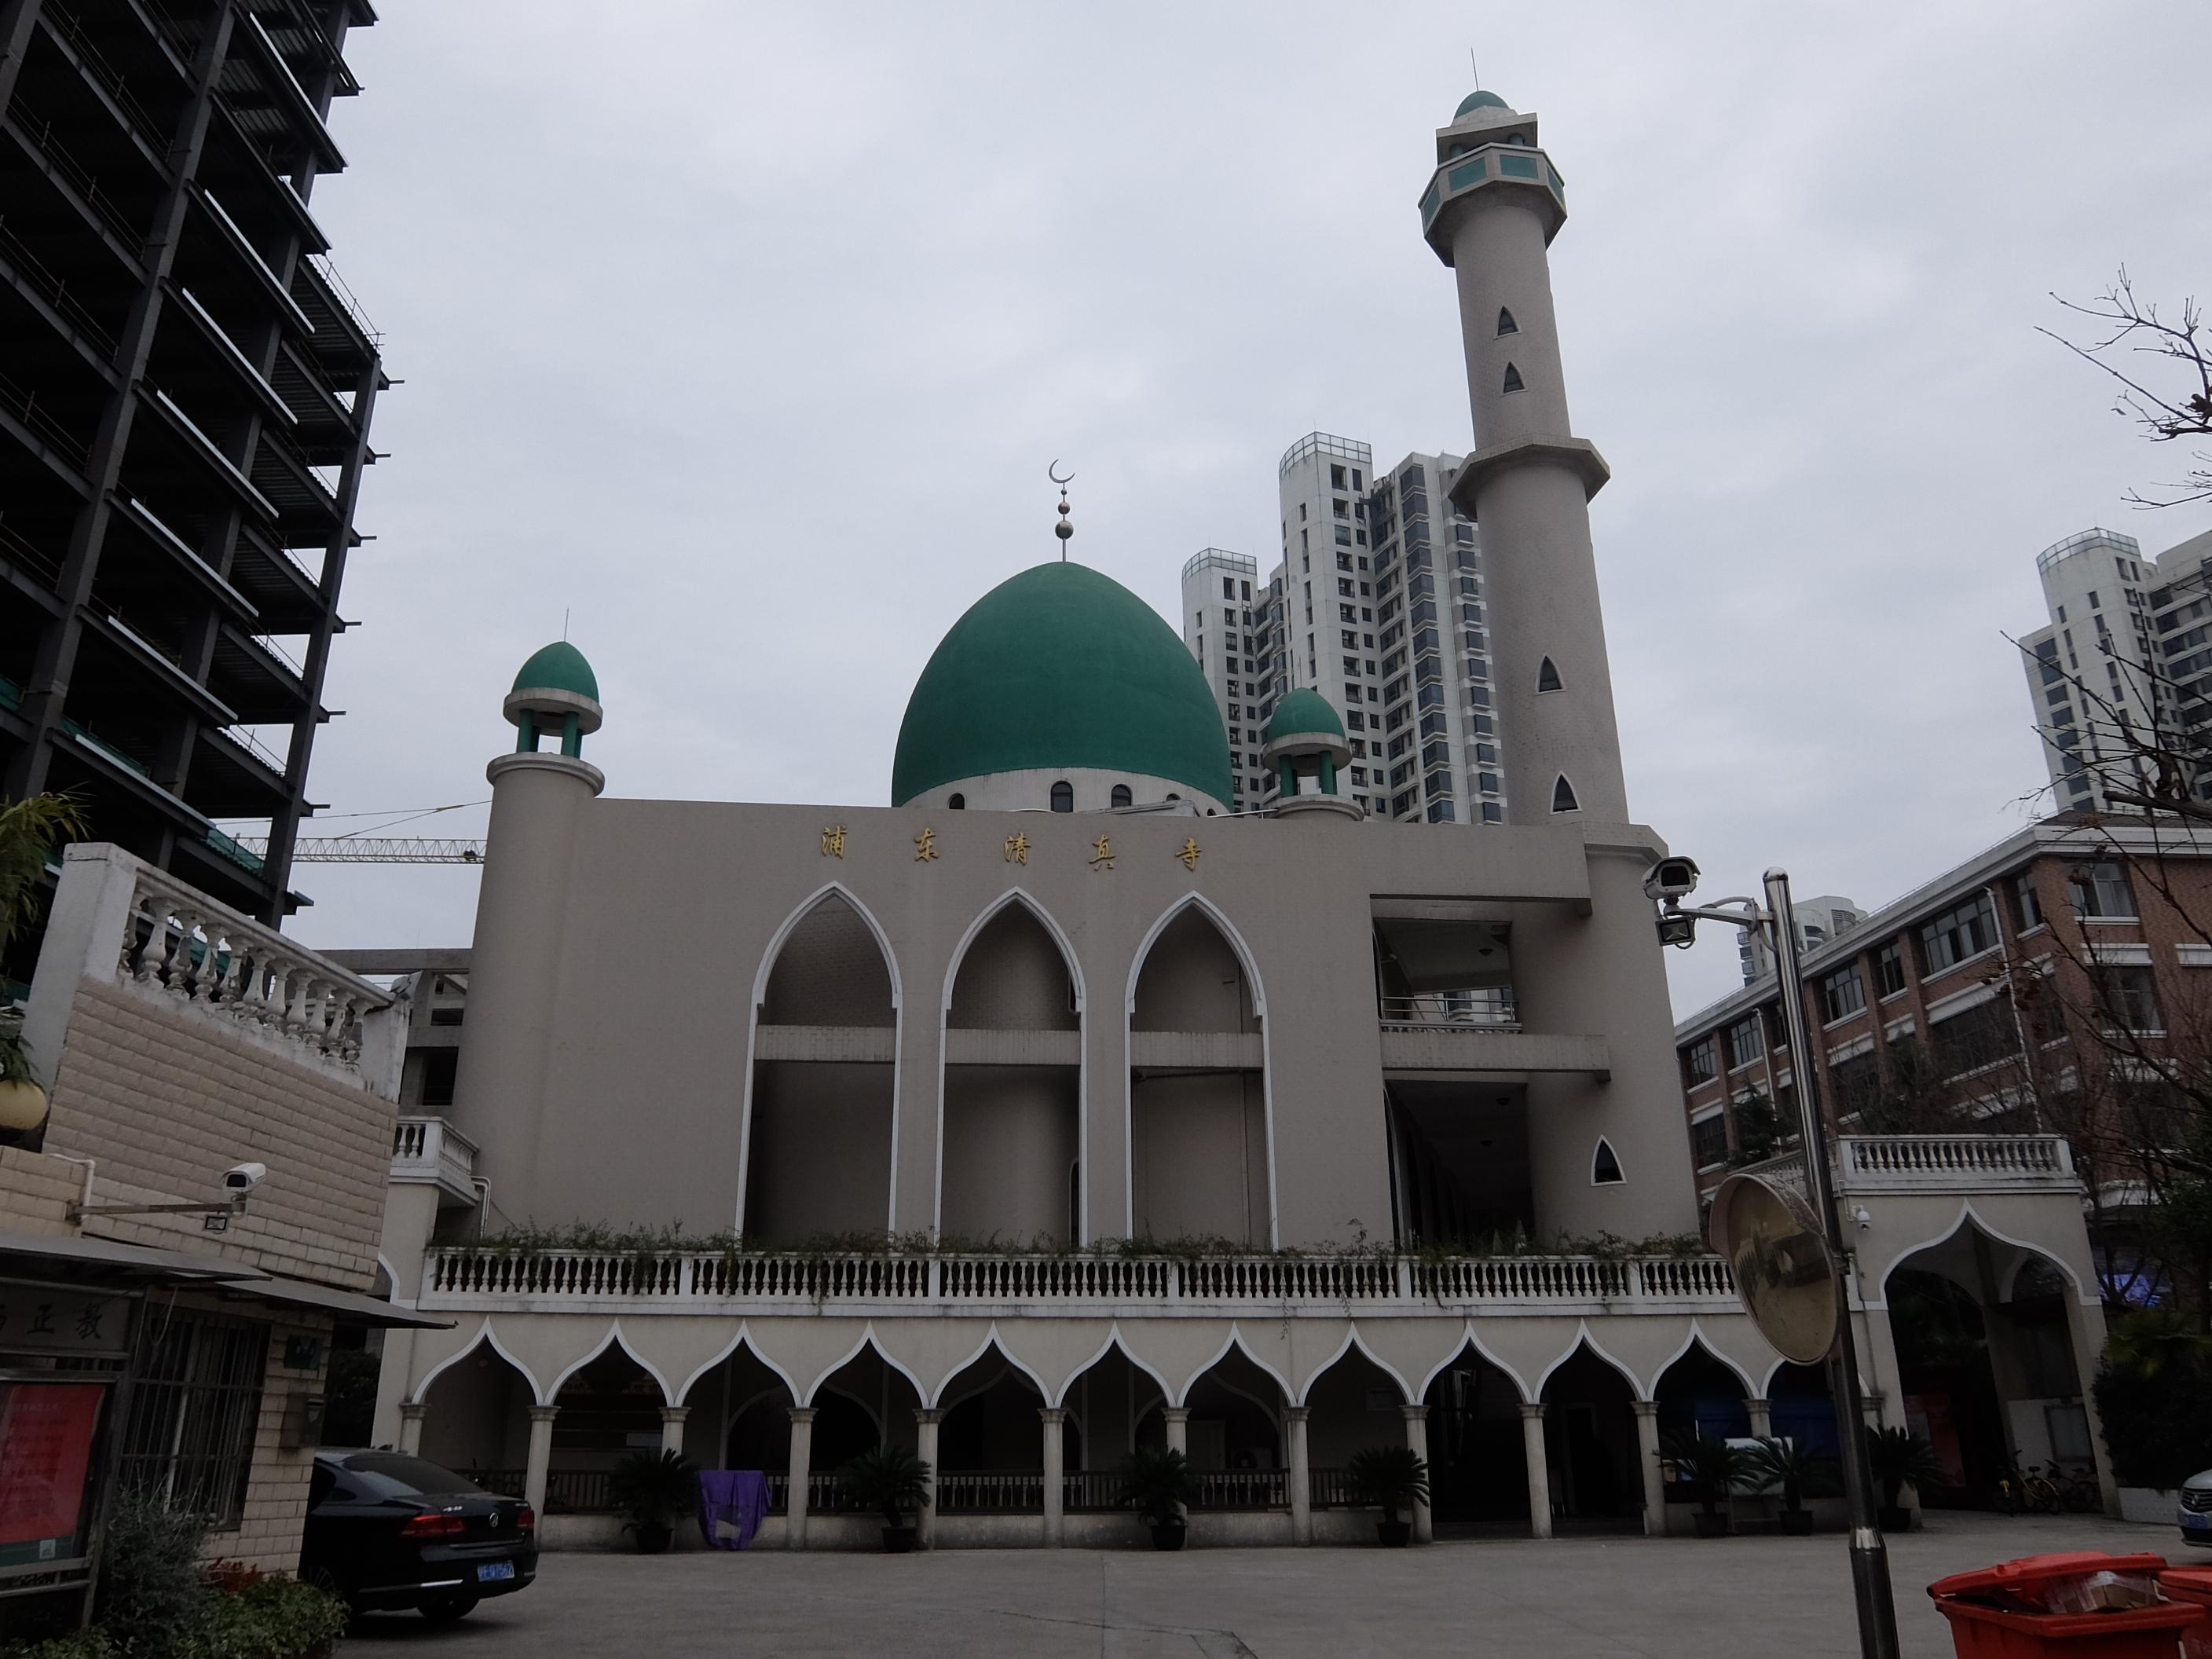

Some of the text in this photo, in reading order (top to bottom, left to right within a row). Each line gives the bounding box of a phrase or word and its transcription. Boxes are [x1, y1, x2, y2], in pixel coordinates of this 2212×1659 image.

[821, 824, 1203, 871] 浦东清真寺
